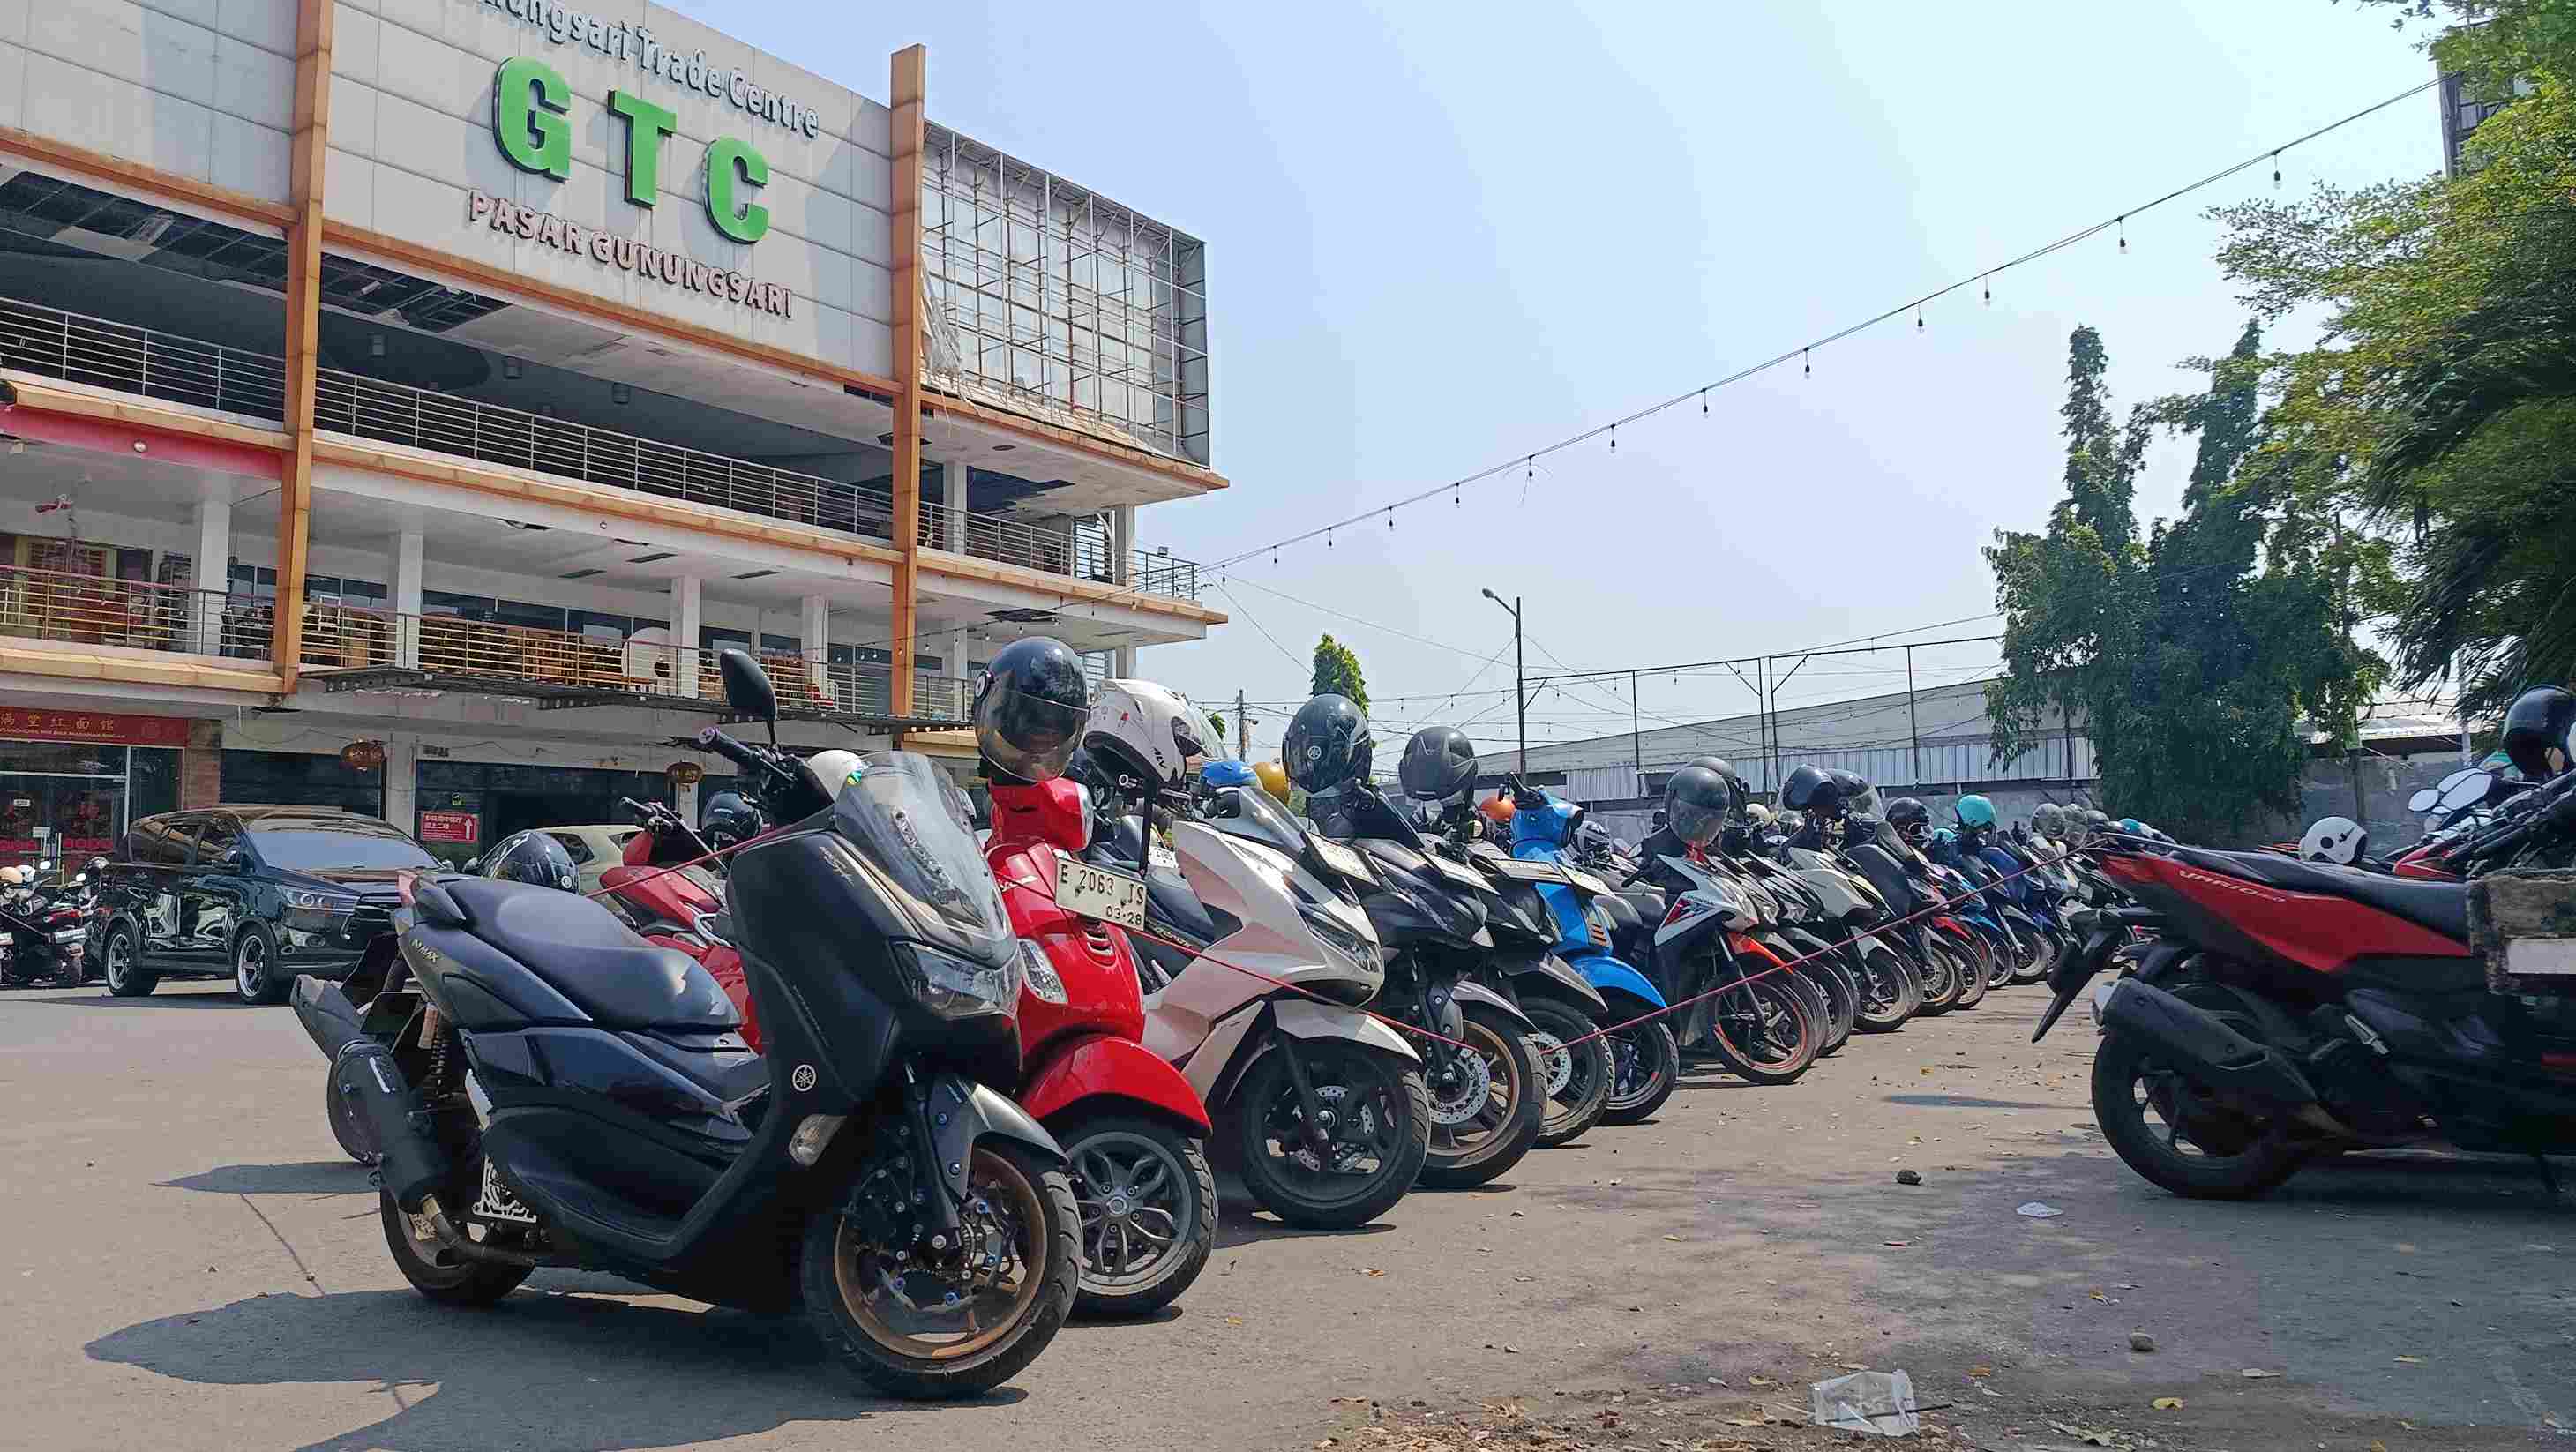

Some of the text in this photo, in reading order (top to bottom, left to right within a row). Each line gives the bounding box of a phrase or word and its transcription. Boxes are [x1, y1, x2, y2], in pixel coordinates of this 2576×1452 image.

[636, 26, 721, 97] Trade
[728, 67, 819, 138] Centre
[469, 191, 794, 318] PASAR GUNUNGSARI
[1060, 864, 1068, 884] E
[1079, 869, 1115, 896] 2063
[1127, 883, 1145, 905] JS
